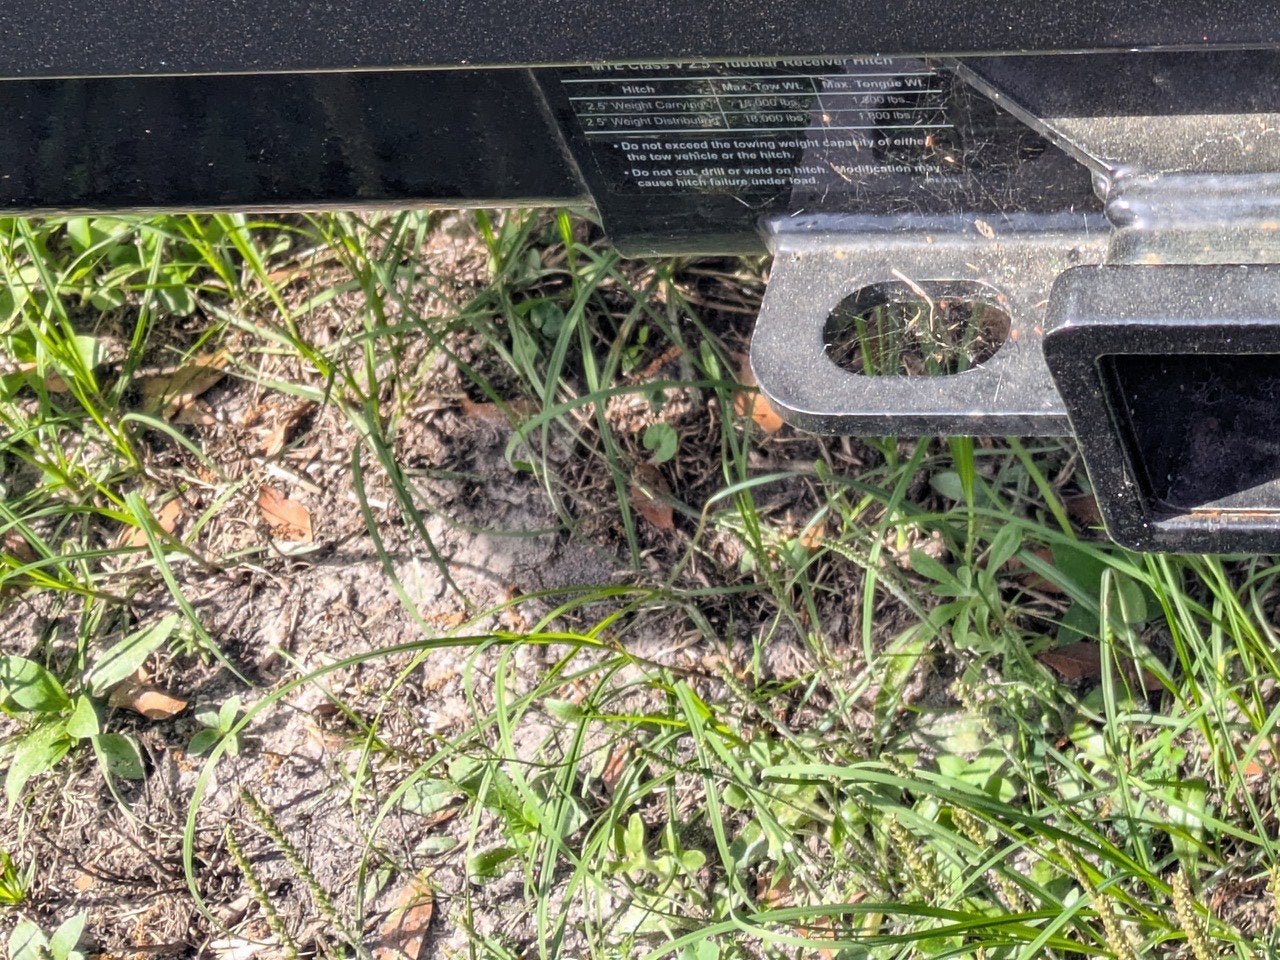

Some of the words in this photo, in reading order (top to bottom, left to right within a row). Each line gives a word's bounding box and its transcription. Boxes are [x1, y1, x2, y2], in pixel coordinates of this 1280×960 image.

[724, 59, 778, 68] Tubular
[783, 58, 847, 67] Receiver
[853, 57, 893, 66] Hitch
[722, 83, 750, 92] Max.
[756, 82, 779, 90] Tow
[782, 81, 803, 90] Wt.
[822, 80, 852, 89] Max.
[856, 79, 902, 89] Tongue
[905, 78, 926, 87] Wt.
[622, 85, 655, 94] Hitch
[611, 101, 652, 111] Weight
[655, 100, 705, 111] Carrying
[610, 116, 651, 127] Weight
[621, 142, 639, 150] Do
[642, 142, 662, 150] not
[665, 140, 708, 150] exceed
[711, 140, 730, 149] the
[734, 140, 776, 150] towing
[778, 139, 820, 149] weight
[823, 138, 874, 148] capacity
[877, 138, 890, 146] of
[894, 137, 930, 146] eithe
[627, 153, 646, 161] the
[649, 153, 672, 161] tow
[675, 151, 718, 161] vehicle
[722, 152, 734, 160] or
[737, 151, 757, 160] the
[632, 169, 649, 177] Do
[652, 168, 672, 176] not
[701, 167, 725, 176] drill
[728, 168, 740, 176] or
[743, 166, 772, 175] weld
[775, 167, 791, 175] on
[794, 166, 829, 175] hitch.
[839, 164, 911, 174] Modification
[914, 164, 940, 174] may
[638, 179, 673, 187] cause
[676, 178, 706, 187] hitch
[709, 177, 747, 187] failure
[752, 176, 785, 186] under
[789, 176, 820, 185] load.
